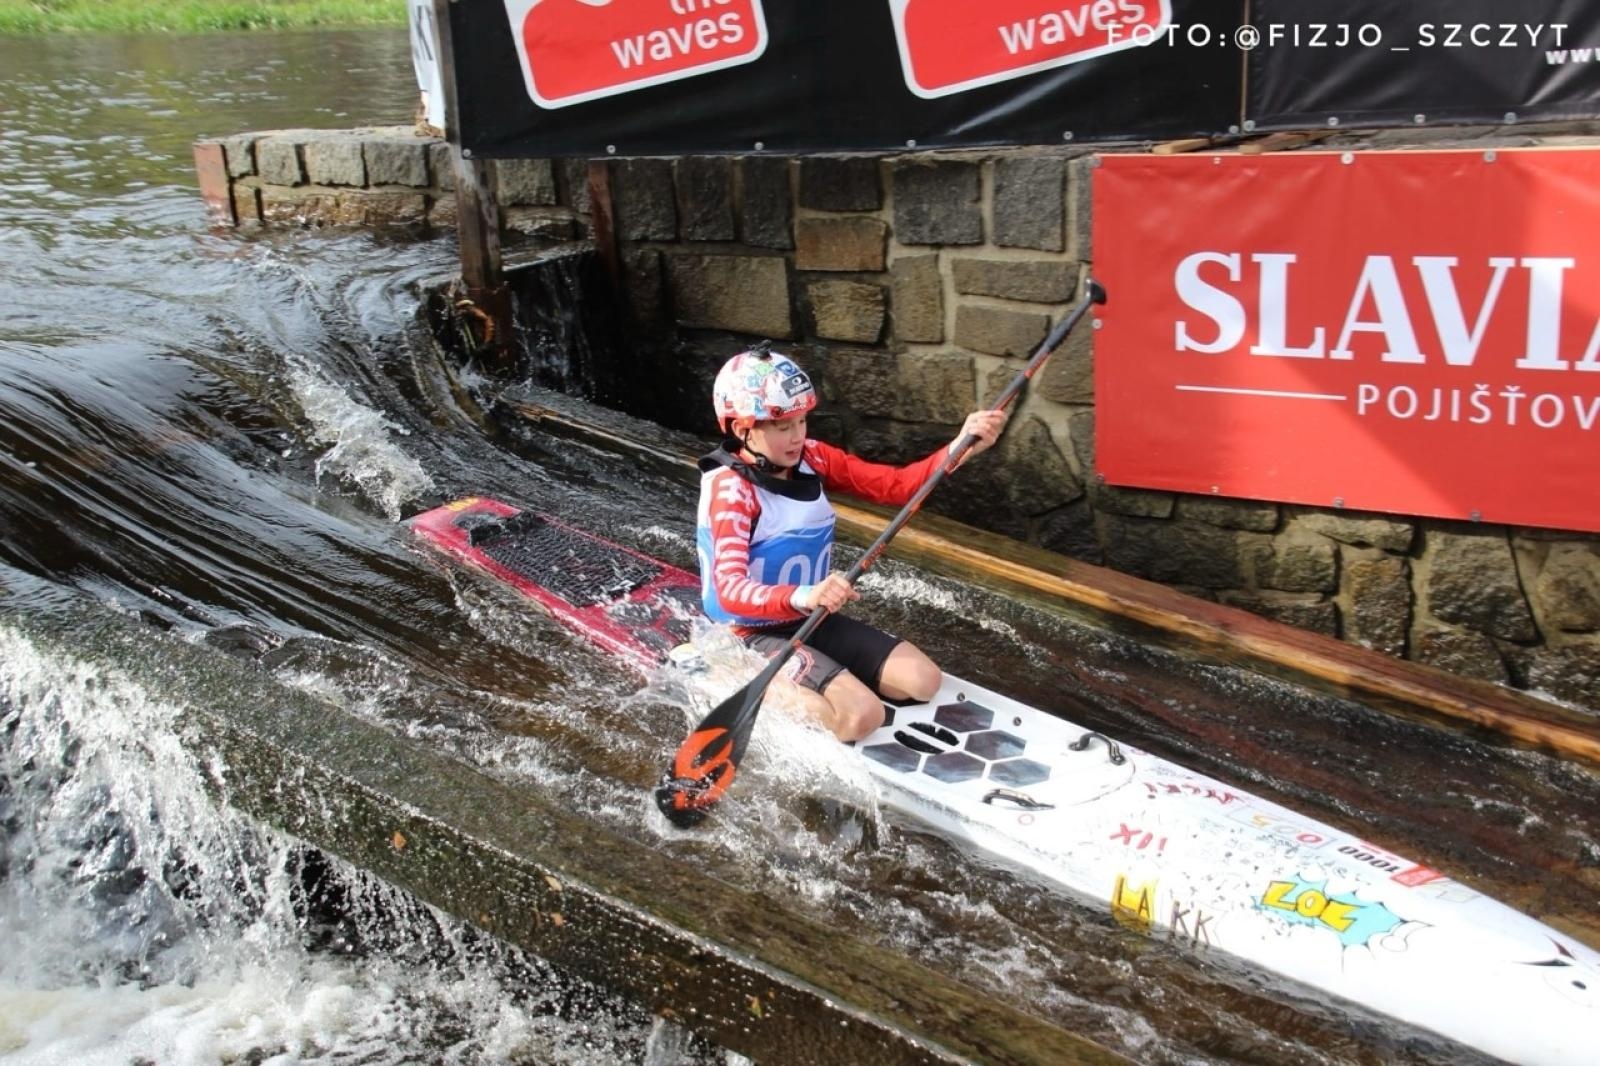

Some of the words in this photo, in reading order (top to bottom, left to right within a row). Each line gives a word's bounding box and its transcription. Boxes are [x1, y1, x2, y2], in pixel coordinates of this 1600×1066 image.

[610, 12, 745, 69] waves
[998, 0, 1146, 55] waves
[1544, 48, 1600, 65] ww
